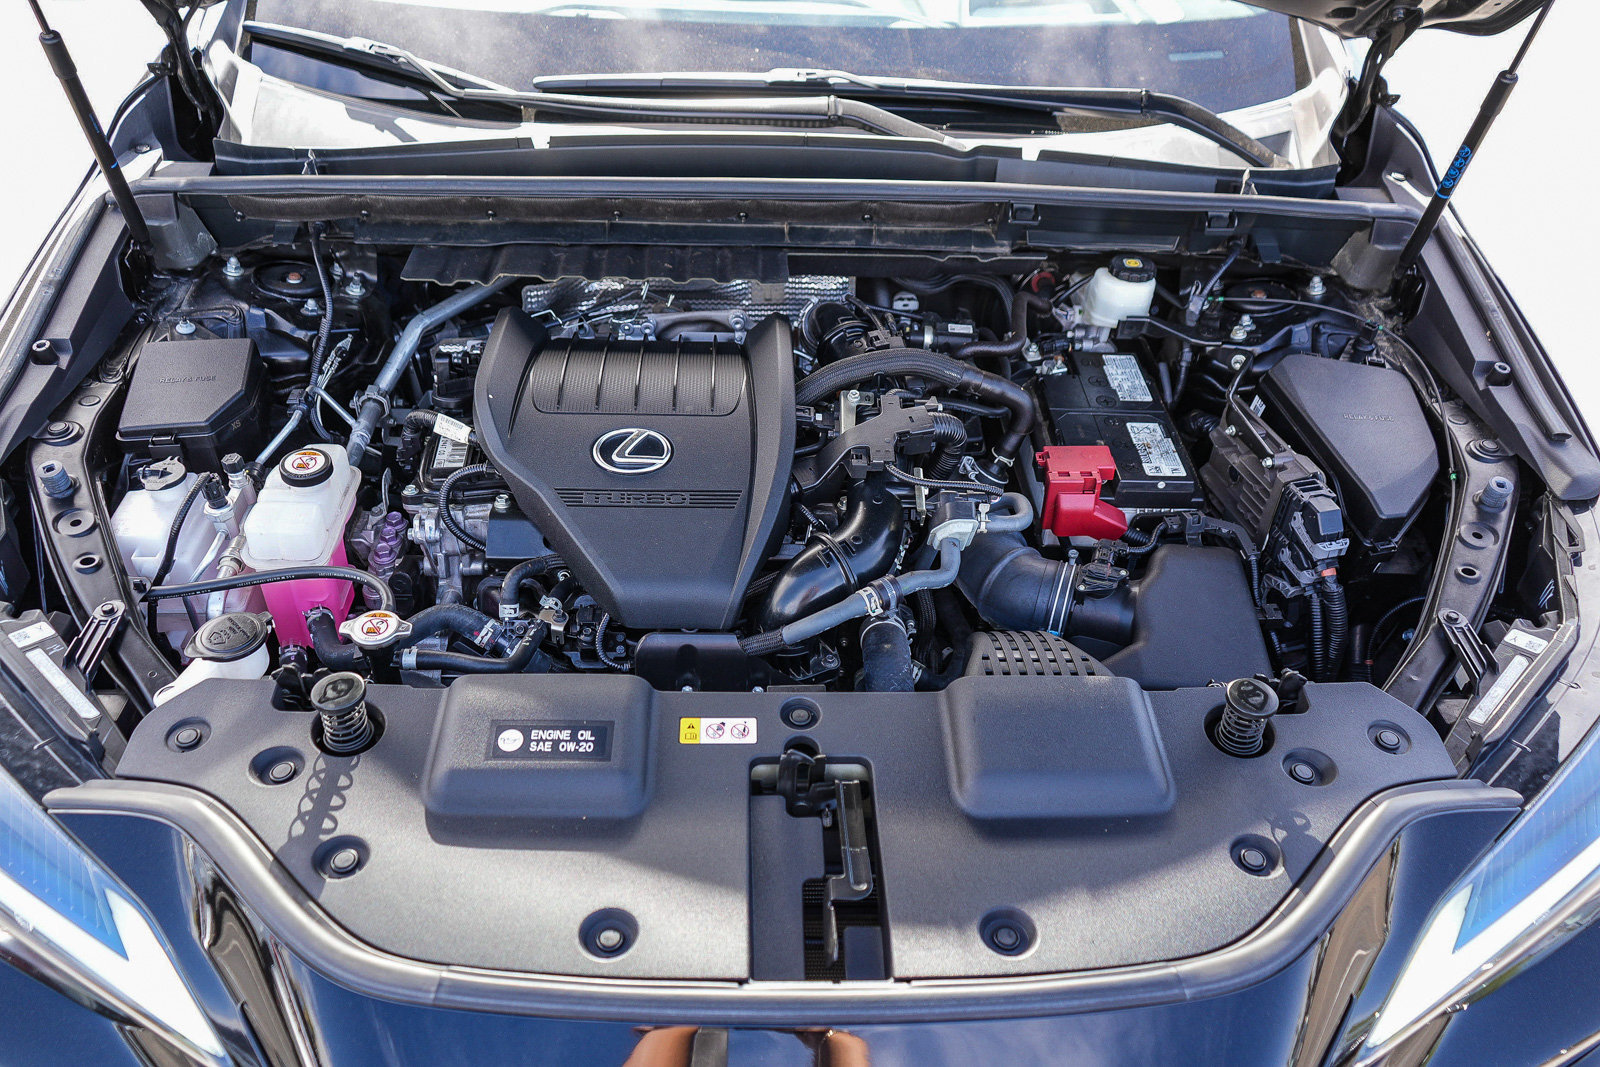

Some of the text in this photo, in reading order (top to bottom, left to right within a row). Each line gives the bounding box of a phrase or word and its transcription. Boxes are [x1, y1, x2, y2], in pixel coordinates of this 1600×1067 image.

[585, 493, 687, 505] TURBO
[530, 729, 595, 740] ENGINE OIL
[529, 741, 594, 752] SAE 0W-20
